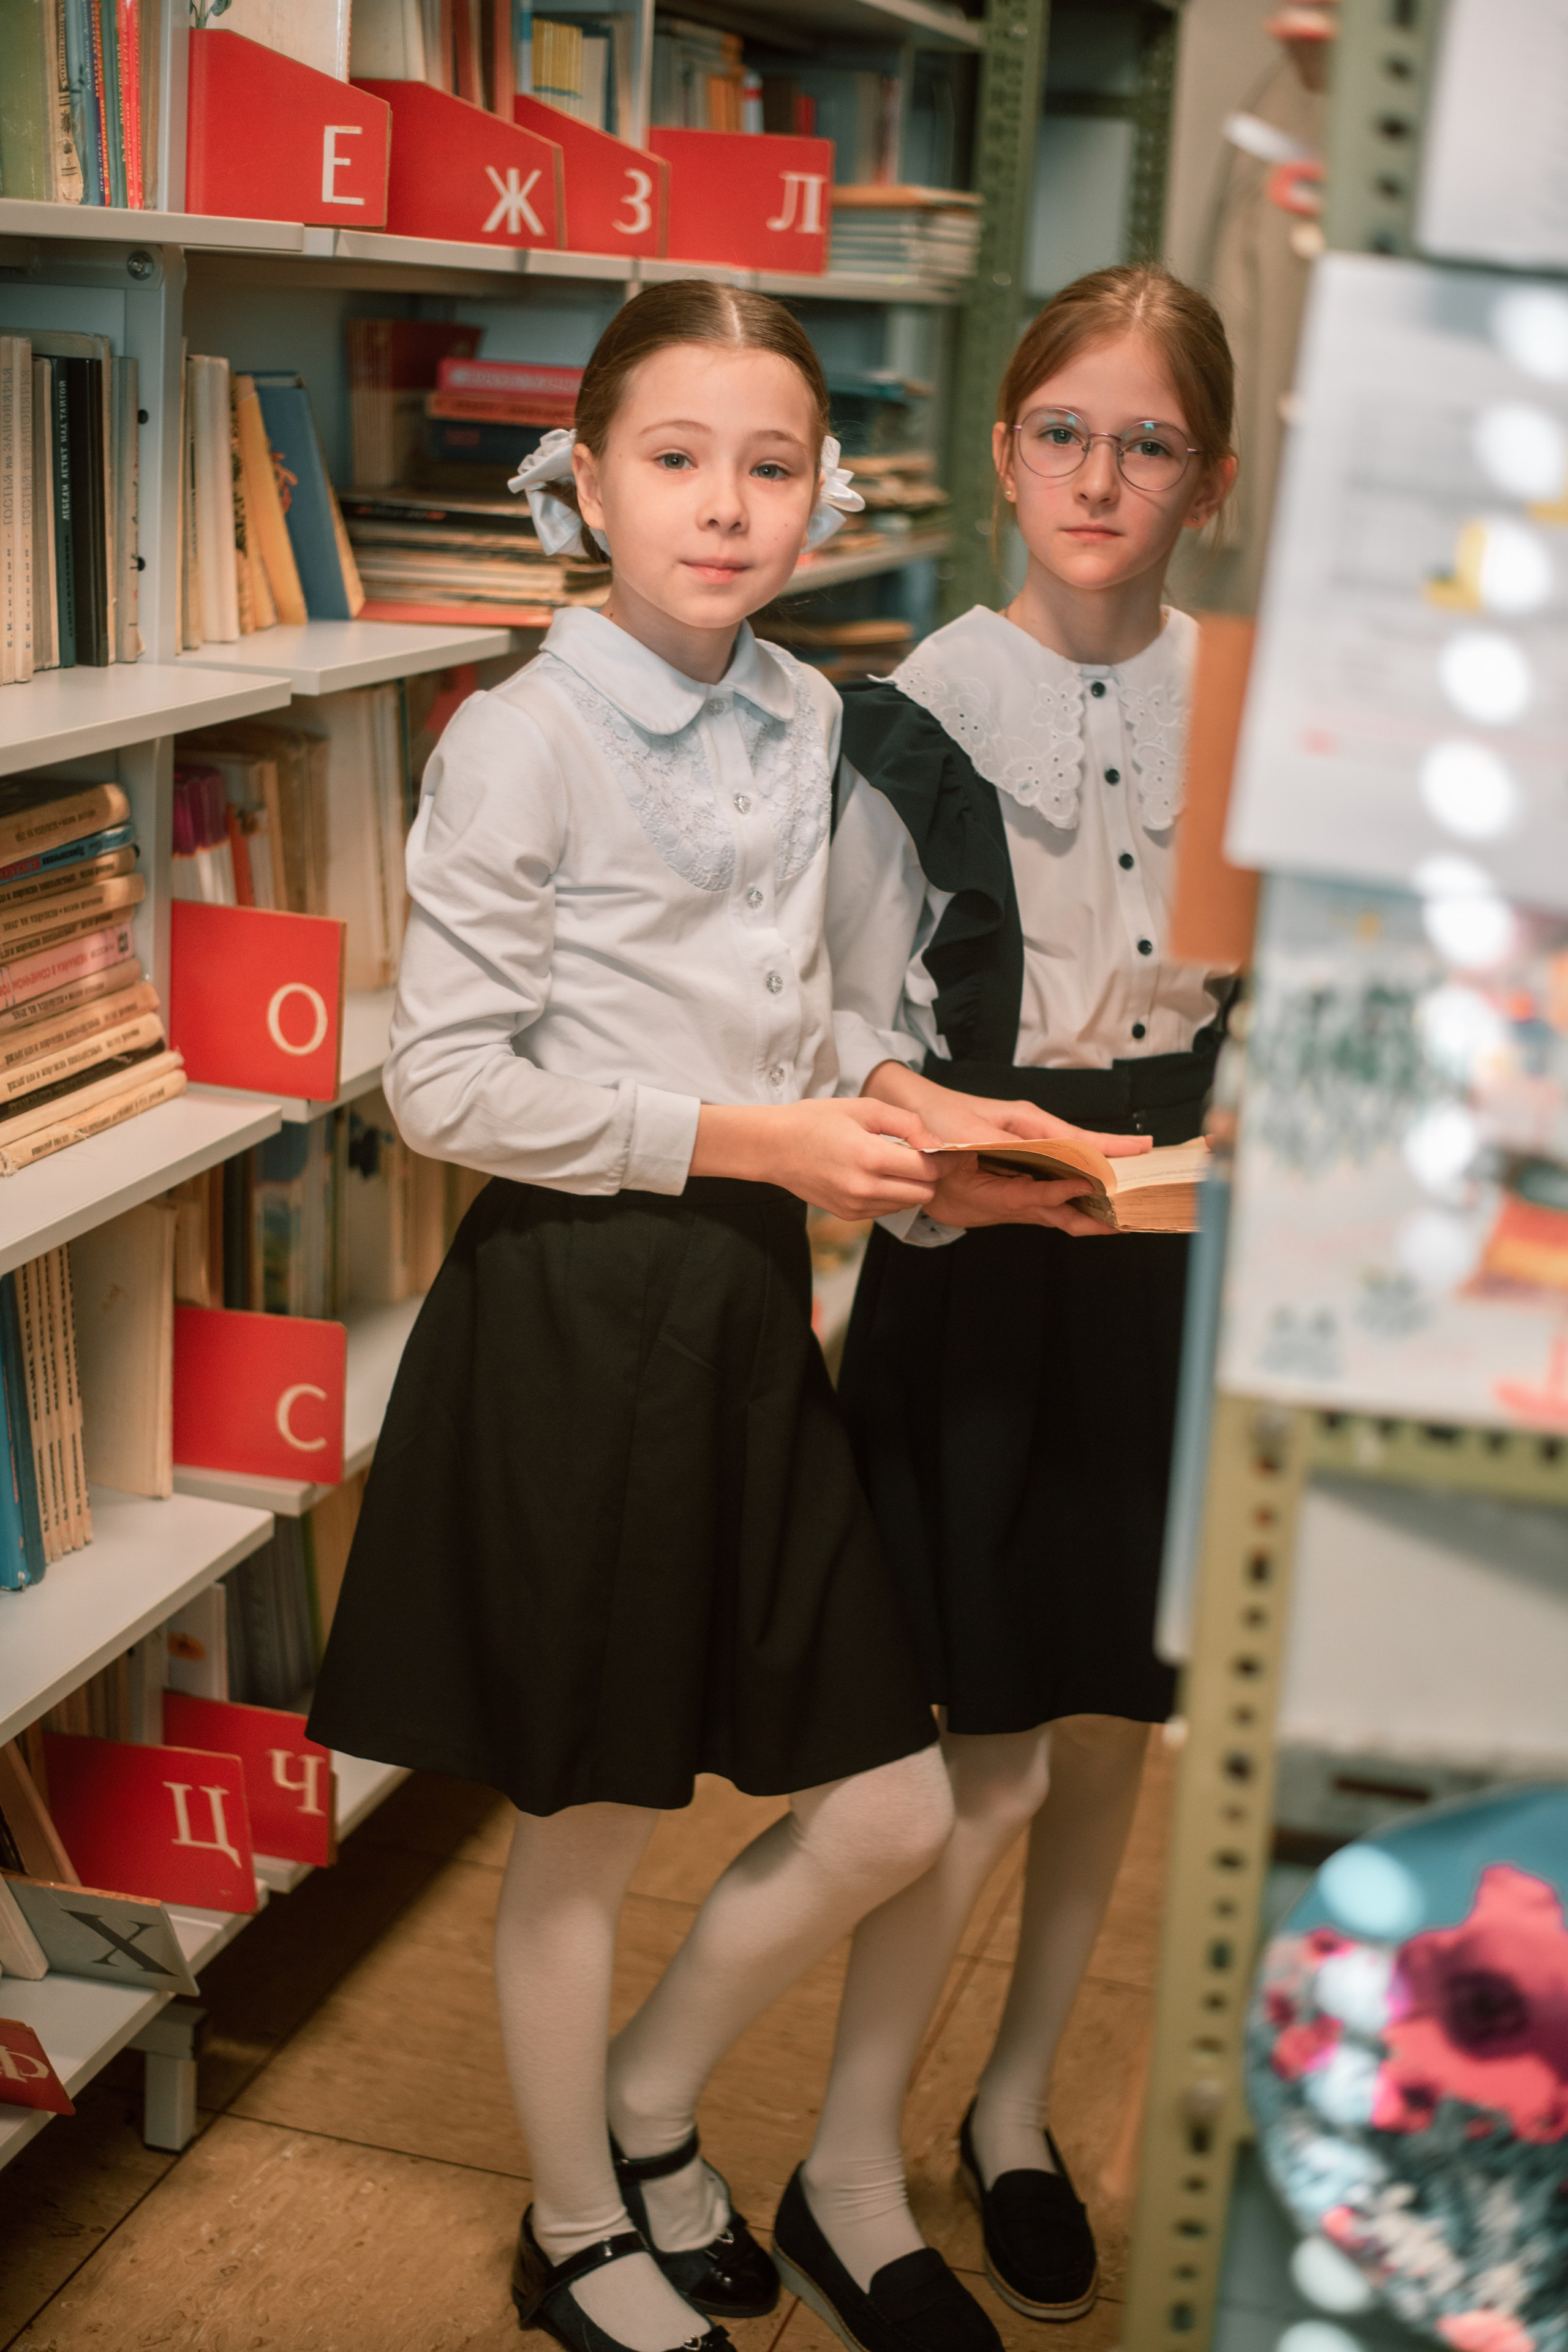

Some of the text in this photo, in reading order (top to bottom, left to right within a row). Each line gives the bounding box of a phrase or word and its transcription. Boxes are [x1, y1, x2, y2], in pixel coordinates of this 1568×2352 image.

[100, 99, 108, 177] Драгунский
[321, 126, 365, 206] Е
[481, 165, 546, 237] Ж
[611, 168, 653, 235] З
[766, 172, 827, 234] Л
[1, 367, 13, 451] ЗАПОЛЯРЬЯ
[20, 369, 31, 453] ЗАПОЛЯРЬЯ
[58, 380, 67, 420] ТАЙГОЙ
[59, 422, 68, 442] НАД
[60, 447, 69, 479] ЛЕТЯТ
[2, 473, 13, 526] ГОСТЬЯ
[21, 475, 32, 526] ГОСТЬЯ
[61, 483, 70, 521] ЛЕБЕДИ
[267, 982, 329, 1056] О
[276, 1384, 327, 1452] С
[269, 1749, 326, 1815] Ч
[162, 1781, 242, 1868] Ц
[61, 1908, 179, 1978] Х
